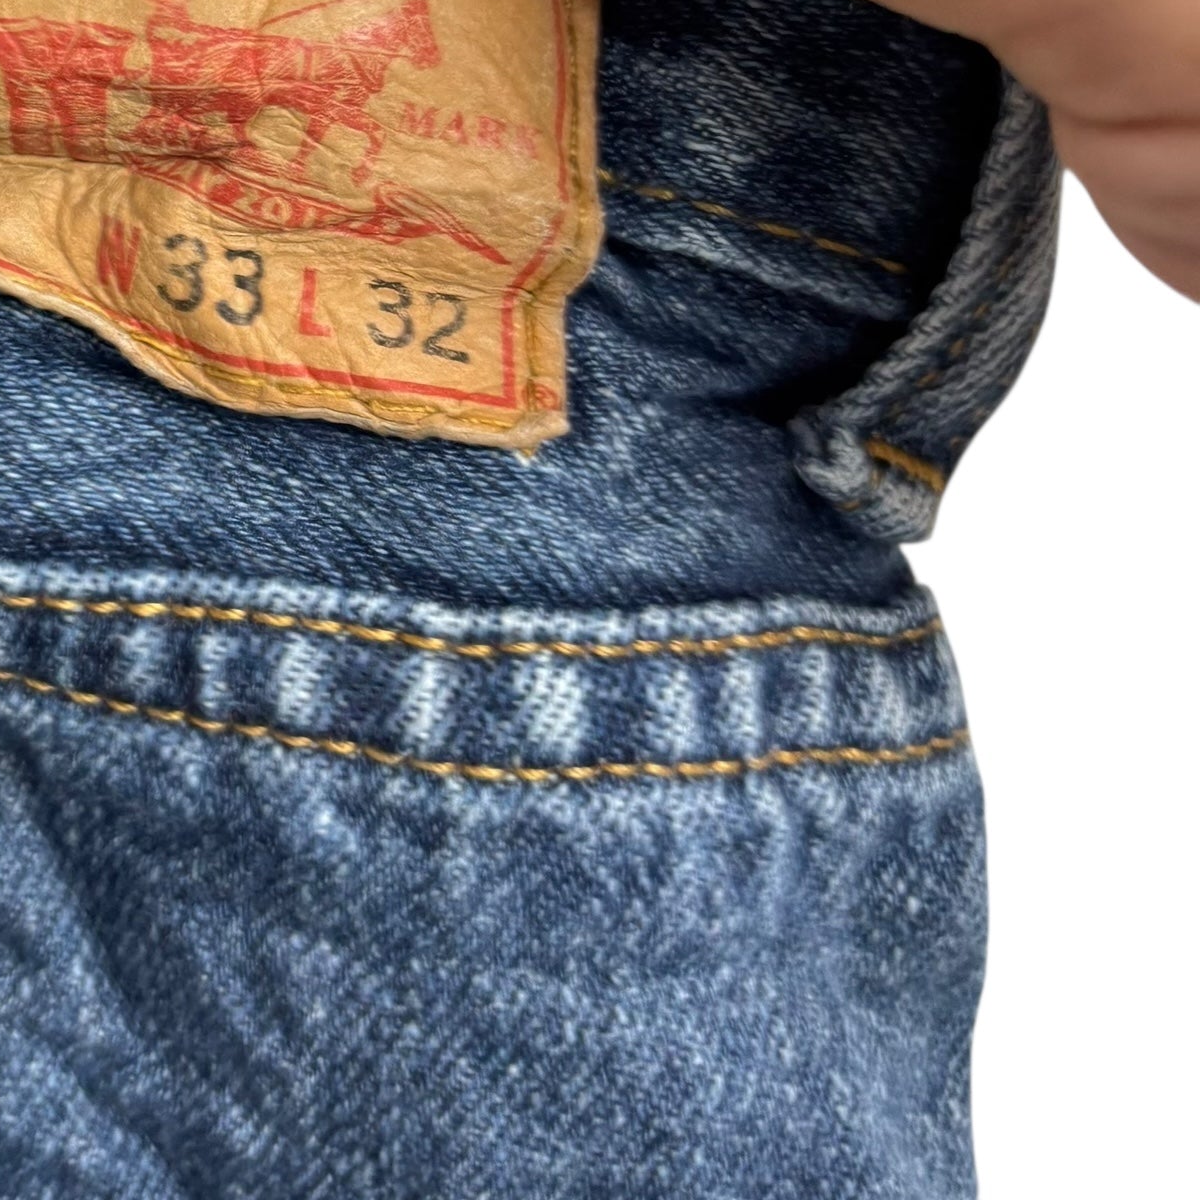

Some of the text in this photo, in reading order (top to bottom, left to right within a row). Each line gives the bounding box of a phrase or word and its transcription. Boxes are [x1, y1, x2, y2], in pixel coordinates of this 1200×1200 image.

[402, 103, 541, 159] MARK
[157, 233, 264, 327] 33
[298, 266, 332, 338] L
[367, 275, 471, 365] 32
